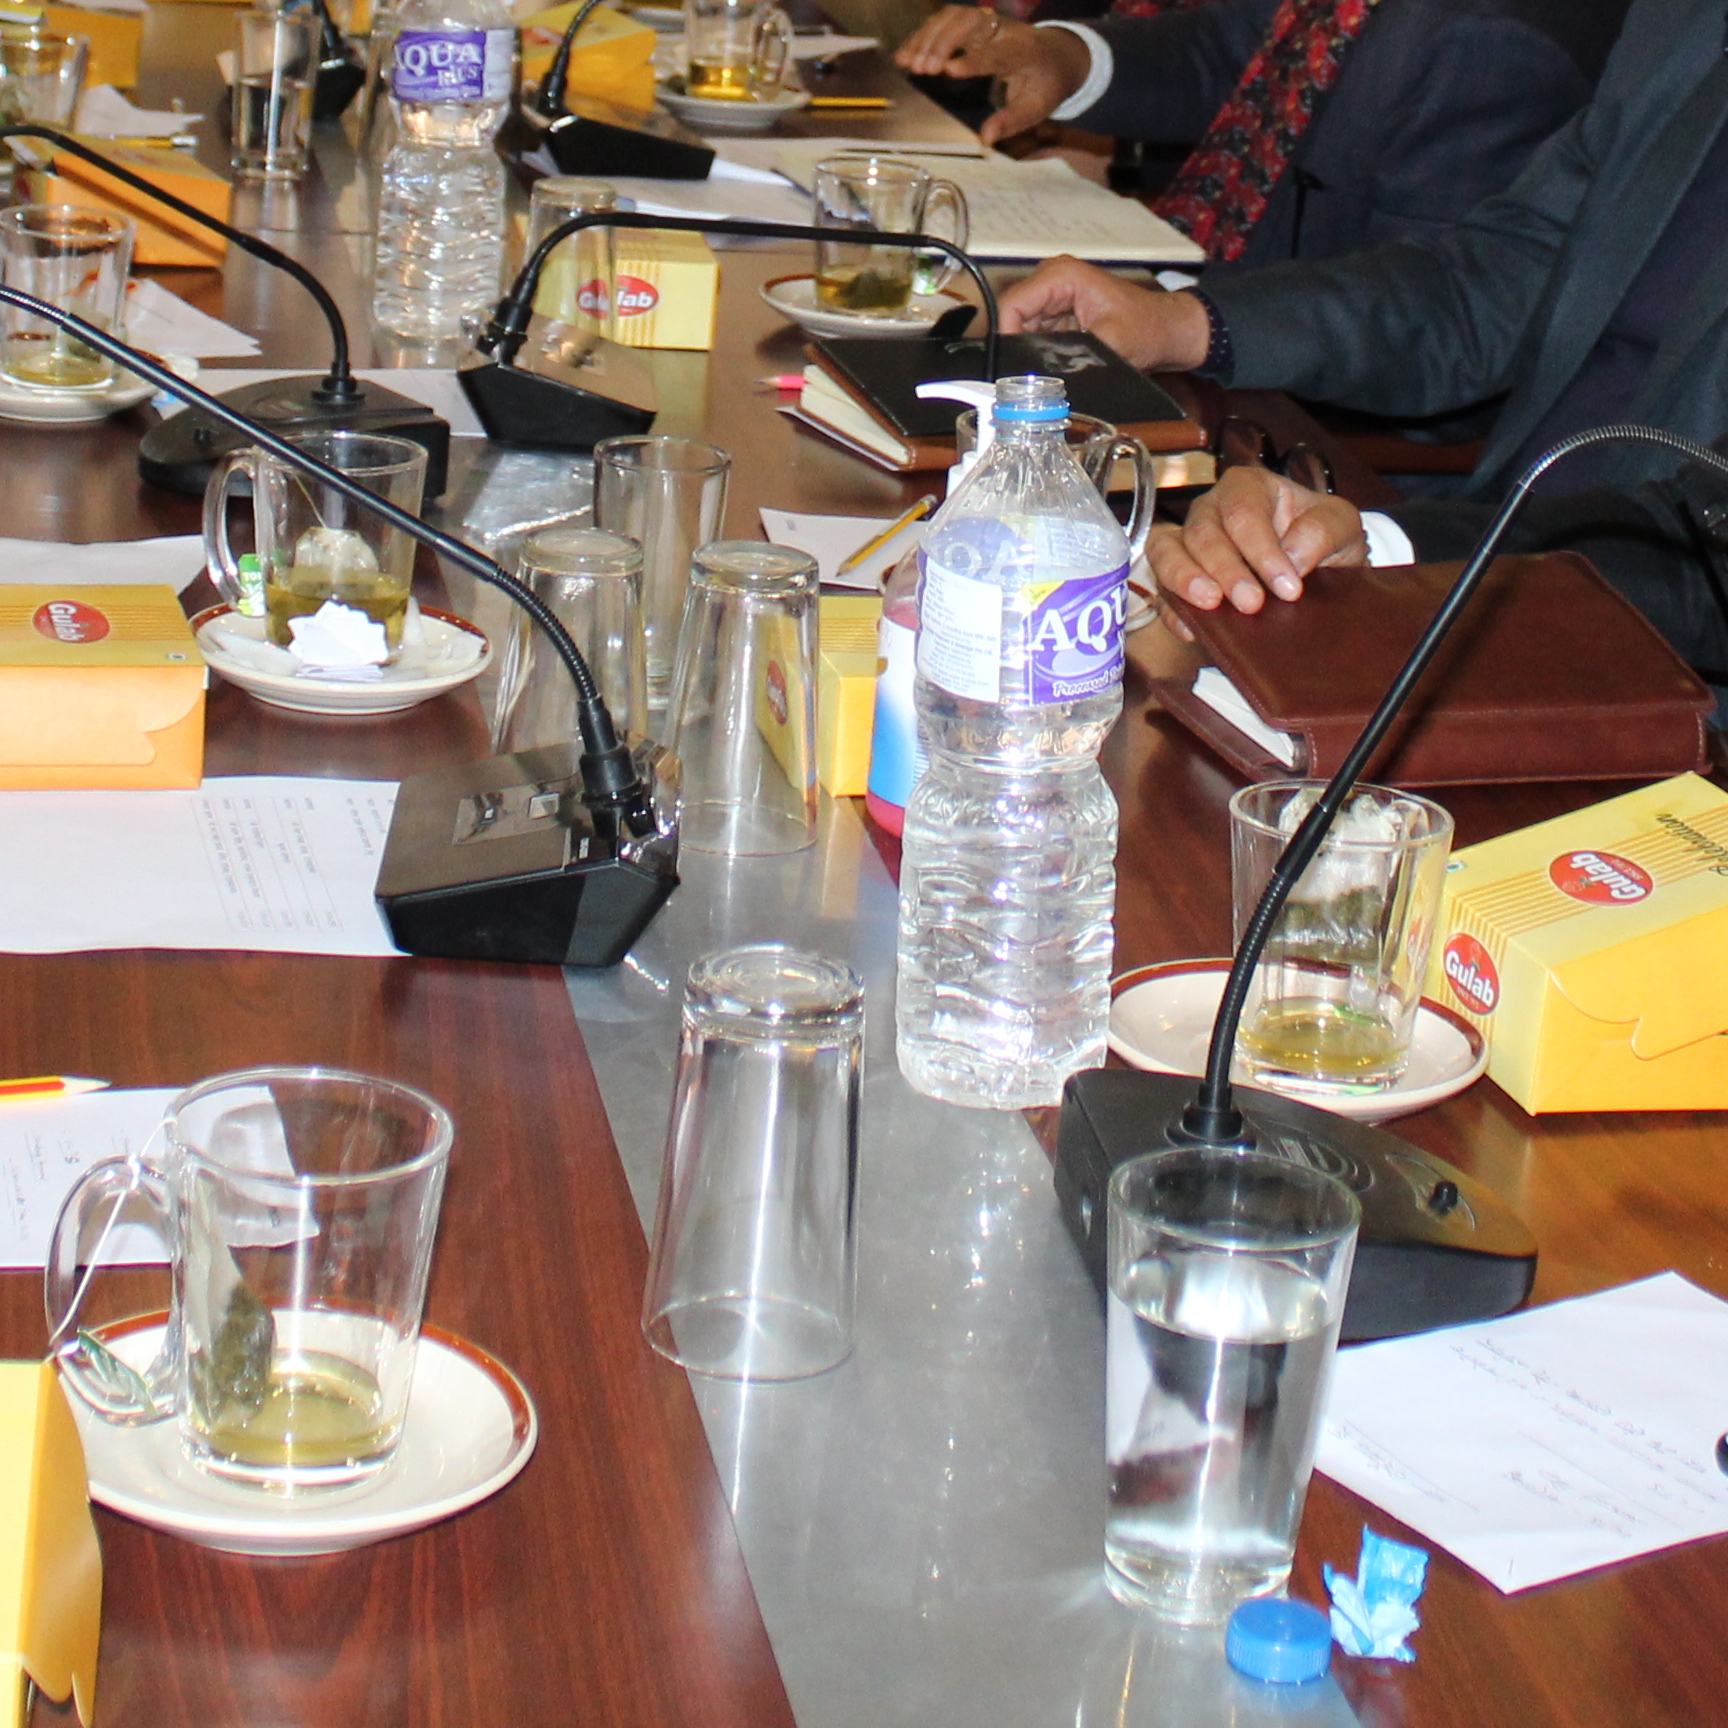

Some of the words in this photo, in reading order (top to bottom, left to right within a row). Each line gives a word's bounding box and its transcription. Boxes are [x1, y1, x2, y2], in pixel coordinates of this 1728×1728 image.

[47, 603, 85, 641] Gulab
[1053, 670, 1109, 698] Processed
[1570, 851, 1648, 901] Gulab
[1445, 949, 1494, 1007] Gulab
